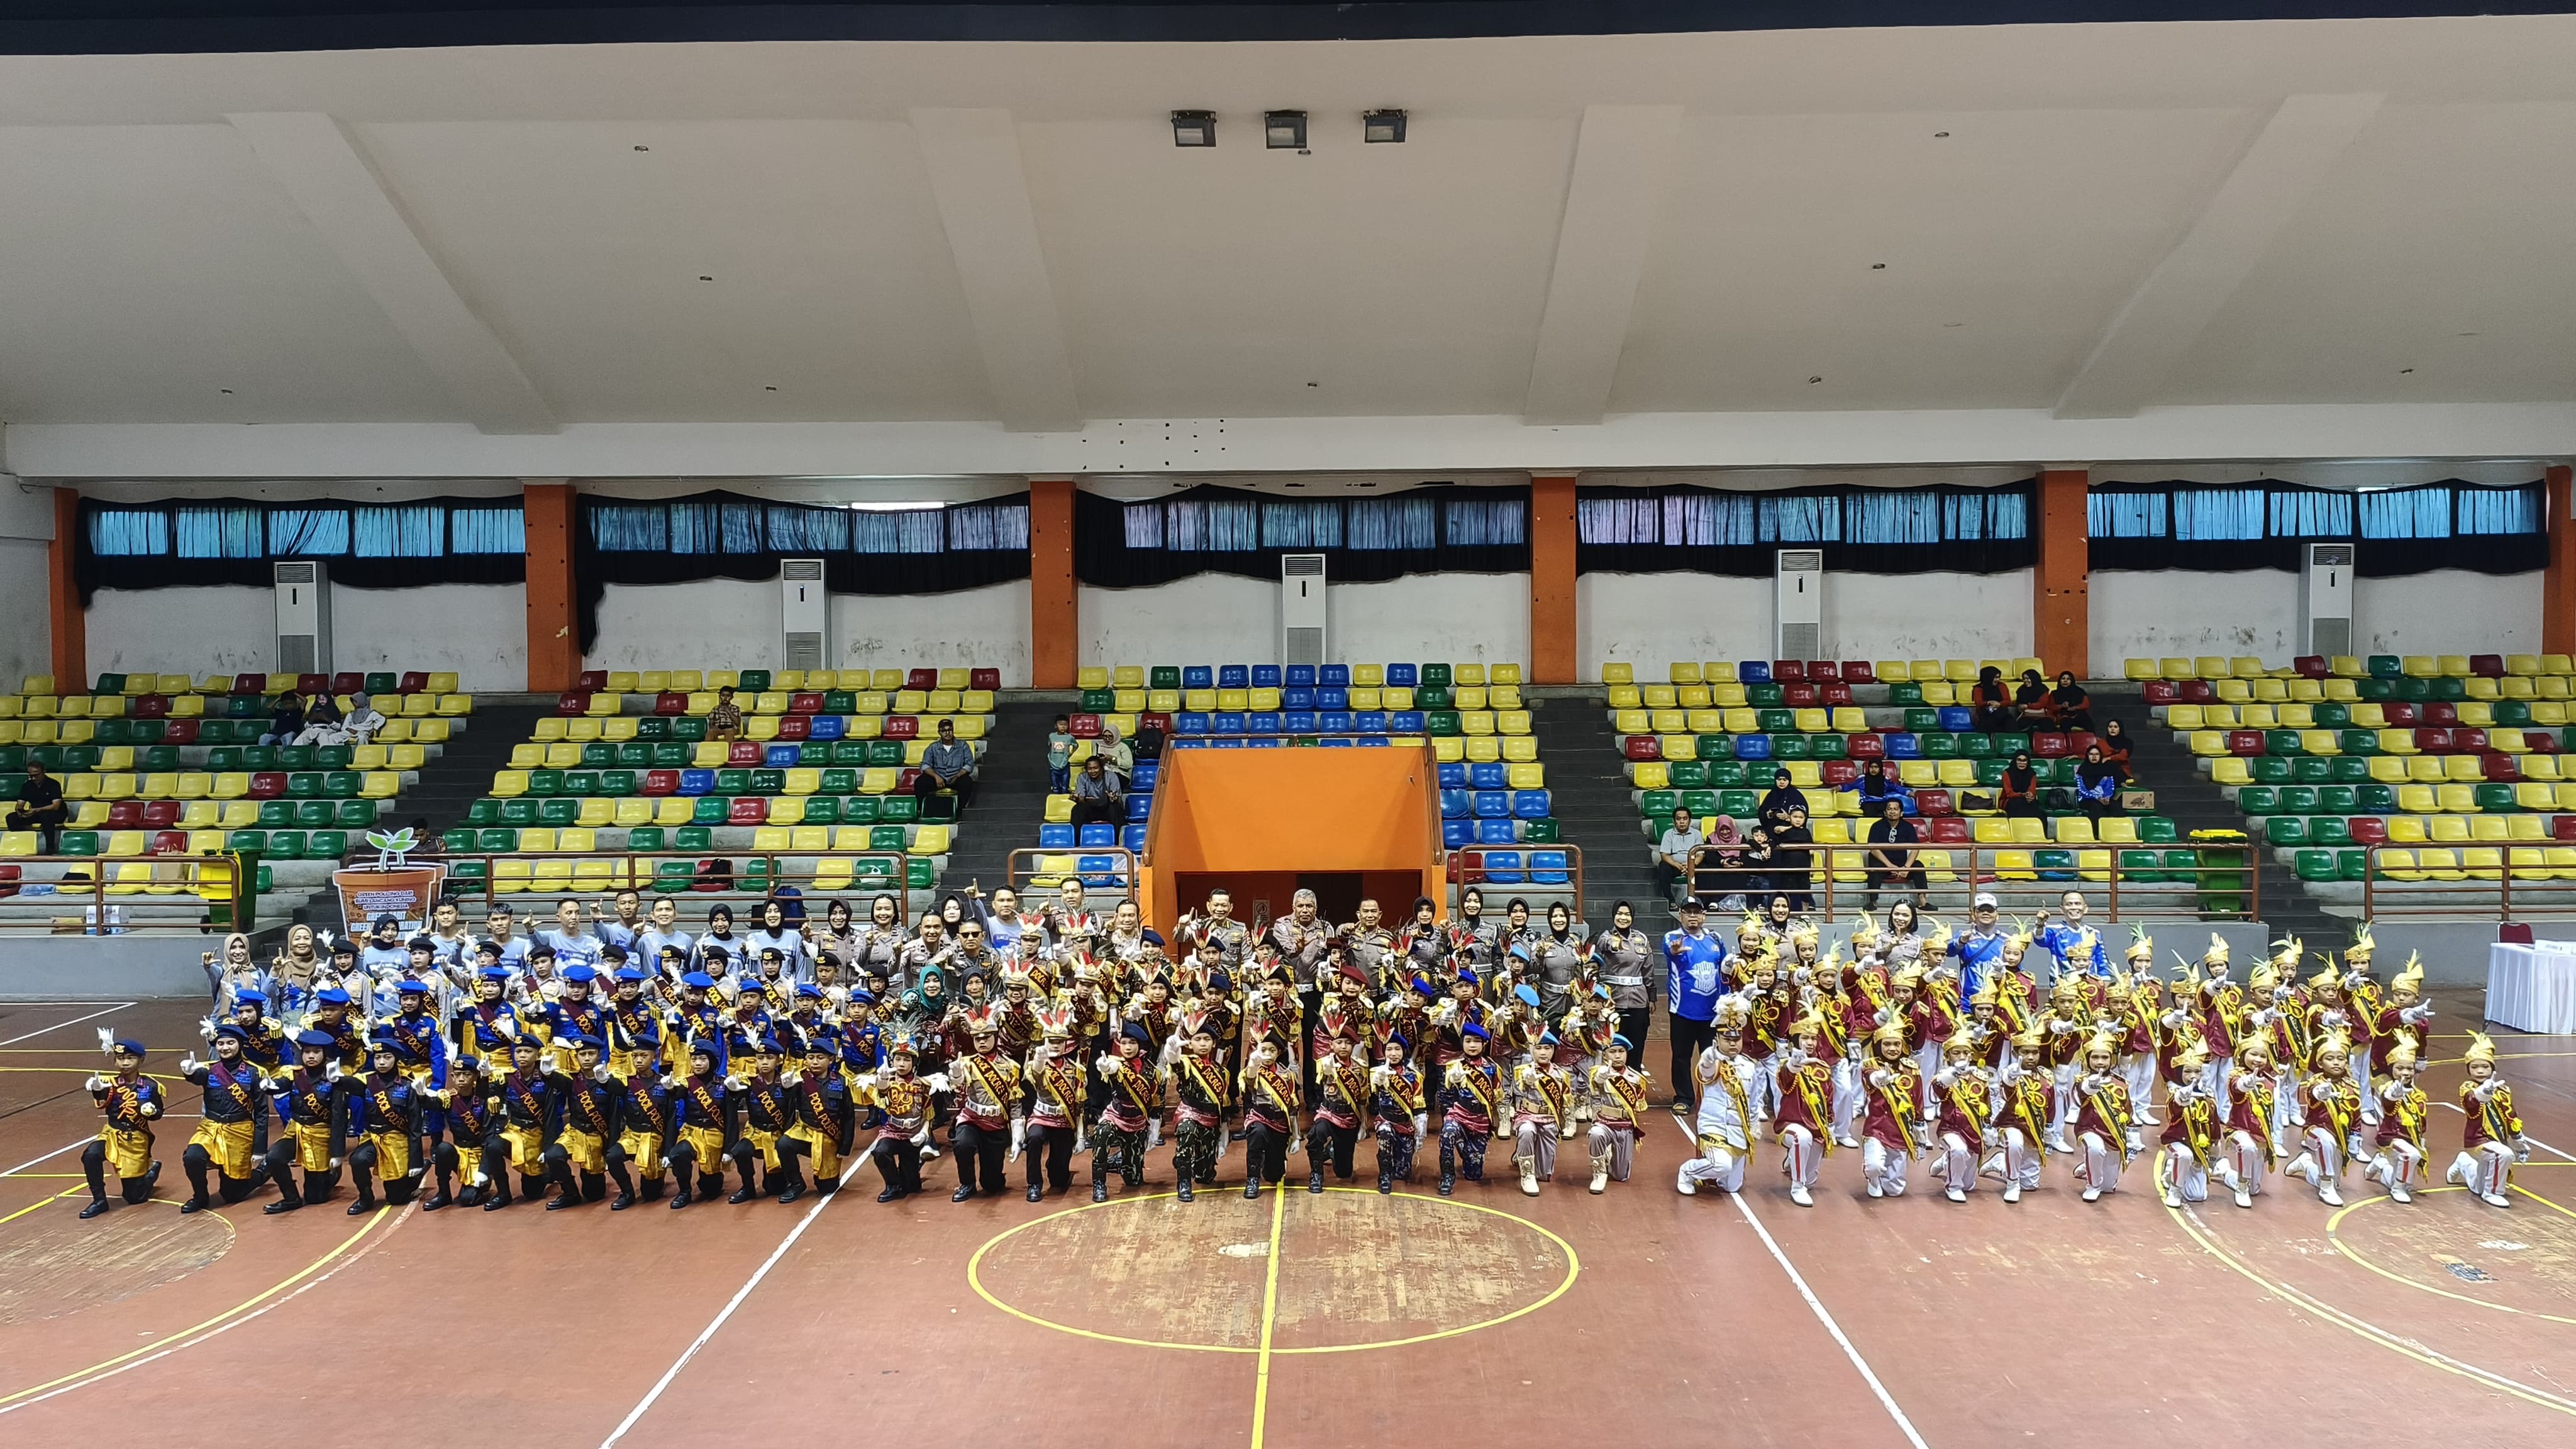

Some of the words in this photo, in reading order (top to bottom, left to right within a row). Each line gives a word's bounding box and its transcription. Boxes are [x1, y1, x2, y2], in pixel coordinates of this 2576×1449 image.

[985, 1070, 1005, 1095] POLRES
[1055, 1079, 1074, 1104] POLRES
[1202, 1068, 1223, 1093] POLRES
[1615, 1079, 1635, 1104] POLRES
[520, 1092, 539, 1114] POCIL
[577, 1091, 595, 1114] POCIL
[635, 1089, 653, 1112] POCIL
[693, 1086, 713, 1109] POCIL
[758, 1091, 775, 1114] POCIL
[808, 1092, 823, 1114] POCIL
